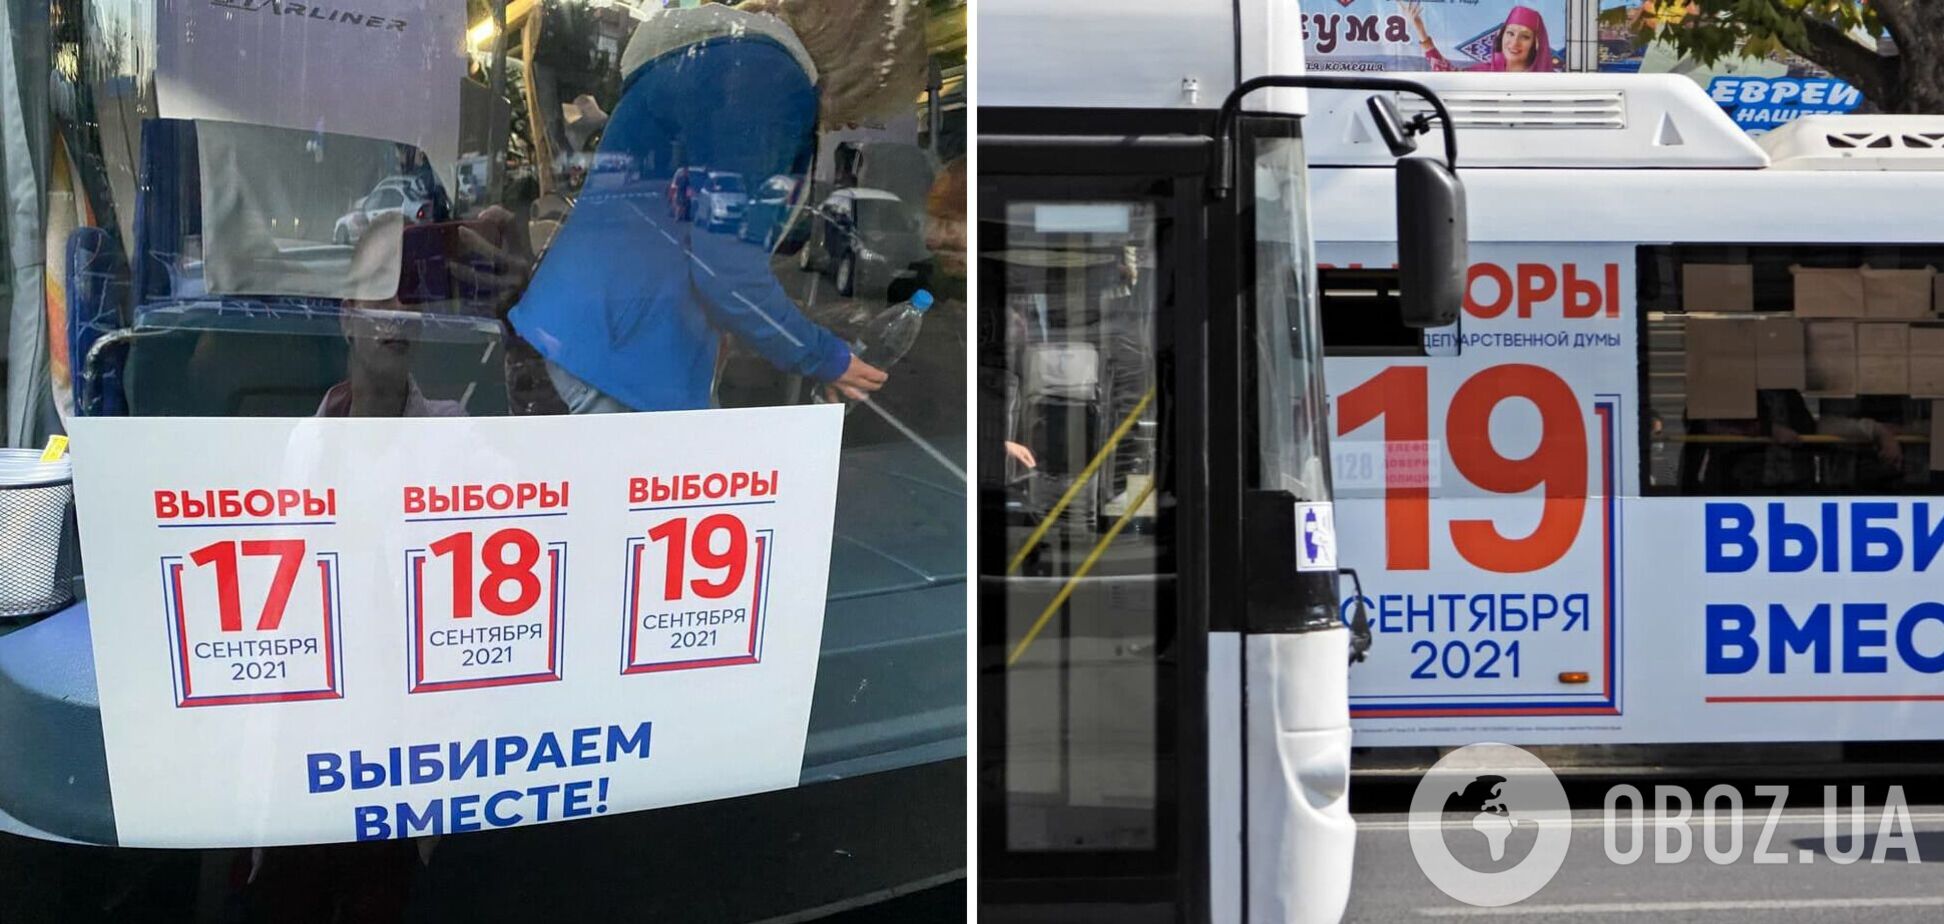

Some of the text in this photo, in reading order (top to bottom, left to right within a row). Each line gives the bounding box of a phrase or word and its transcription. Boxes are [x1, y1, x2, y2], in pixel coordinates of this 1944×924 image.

[211, 0, 408, 32] TARLINER
[1737, 108, 1844, 122] НАШ
[1573, 332, 1621, 348] ДУМЫ
[1382, 442, 1438, 452] ЕЛЕФО
[1383, 458, 1438, 468] ОВЕРИ
[1336, 452, 1373, 480] 128
[1337, 363, 1588, 574] 19
[403, 481, 570, 514] ВЫБОРЫ
[628, 470, 778, 503] ВЫБОРЫ
[154, 487, 337, 519] ВЫБОРЫ
[648, 512, 749, 602] 19
[190, 538, 306, 633] 17
[429, 527, 542, 620] 18
[643, 608, 746, 630] СЕНТЯБРЯ
[1341, 593, 1590, 634] СЕНТЯБРЯ
[194, 637, 318, 659] СЕНТЯБРЯ
[430, 623, 542, 647] СЕНТЯБРЯ
[670, 630, 717, 649] 2021
[231, 660, 286, 681] 2021
[462, 645, 512, 667] 2021
[1410, 639, 1521, 680] 2021
[306, 721, 653, 794] ВЫБИРАЕМ
[354, 777, 610, 842] ВМЕСТЕ!
